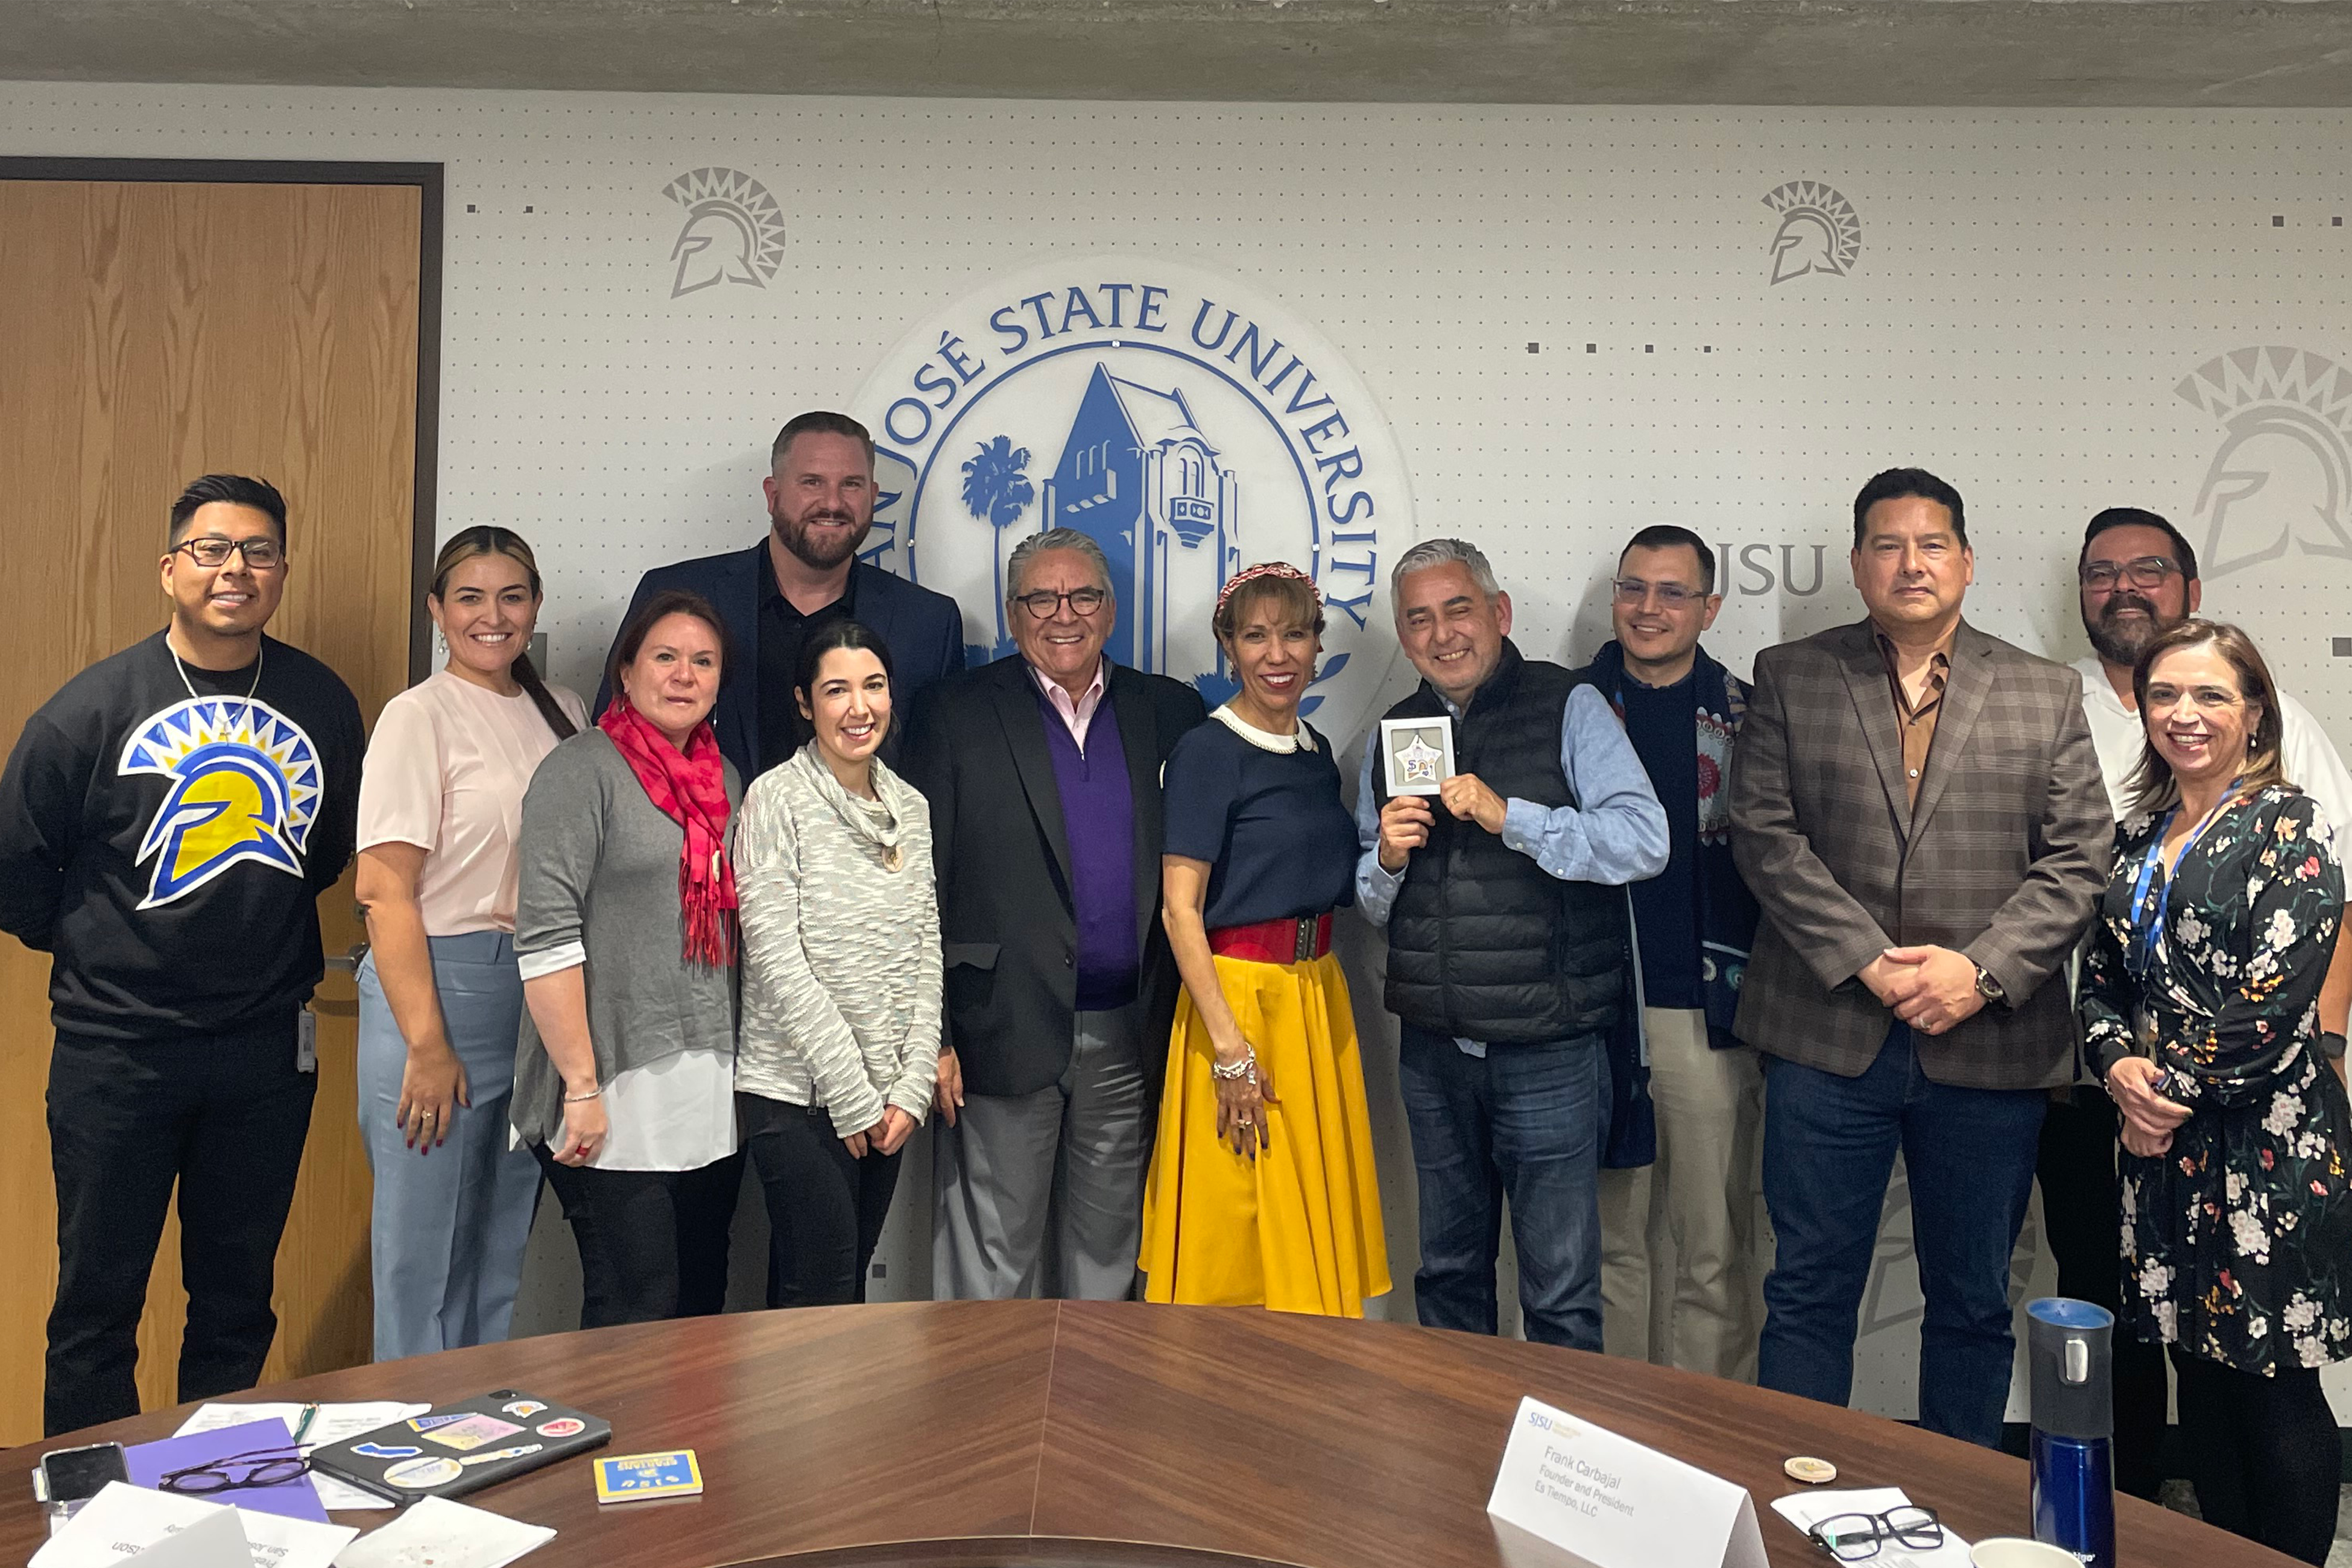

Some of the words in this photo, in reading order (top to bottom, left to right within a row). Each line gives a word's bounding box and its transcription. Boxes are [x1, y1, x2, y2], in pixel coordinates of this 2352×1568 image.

[873, 330, 986, 481] JOSÉ
[990, 283, 1170, 355] STATE
[1190, 298, 1378, 632] UNIVERSITY
[1716, 543, 1828, 599] JSU
[1528, 1412, 1553, 1430] SJSU
[1544, 1446, 1575, 1470] Frank
[1576, 1460, 1622, 1490] Carbajal
[1535, 1479, 1546, 1494] Es
[1580, 1501, 1598, 1517] LLC
[1539, 1464, 1574, 1488] Founder
[1574, 1482, 1593, 1496] and
[1592, 1488, 1635, 1517] President
[112, 1541, 145, 1555] tson
[247, 1541, 267, 1553] Jos
